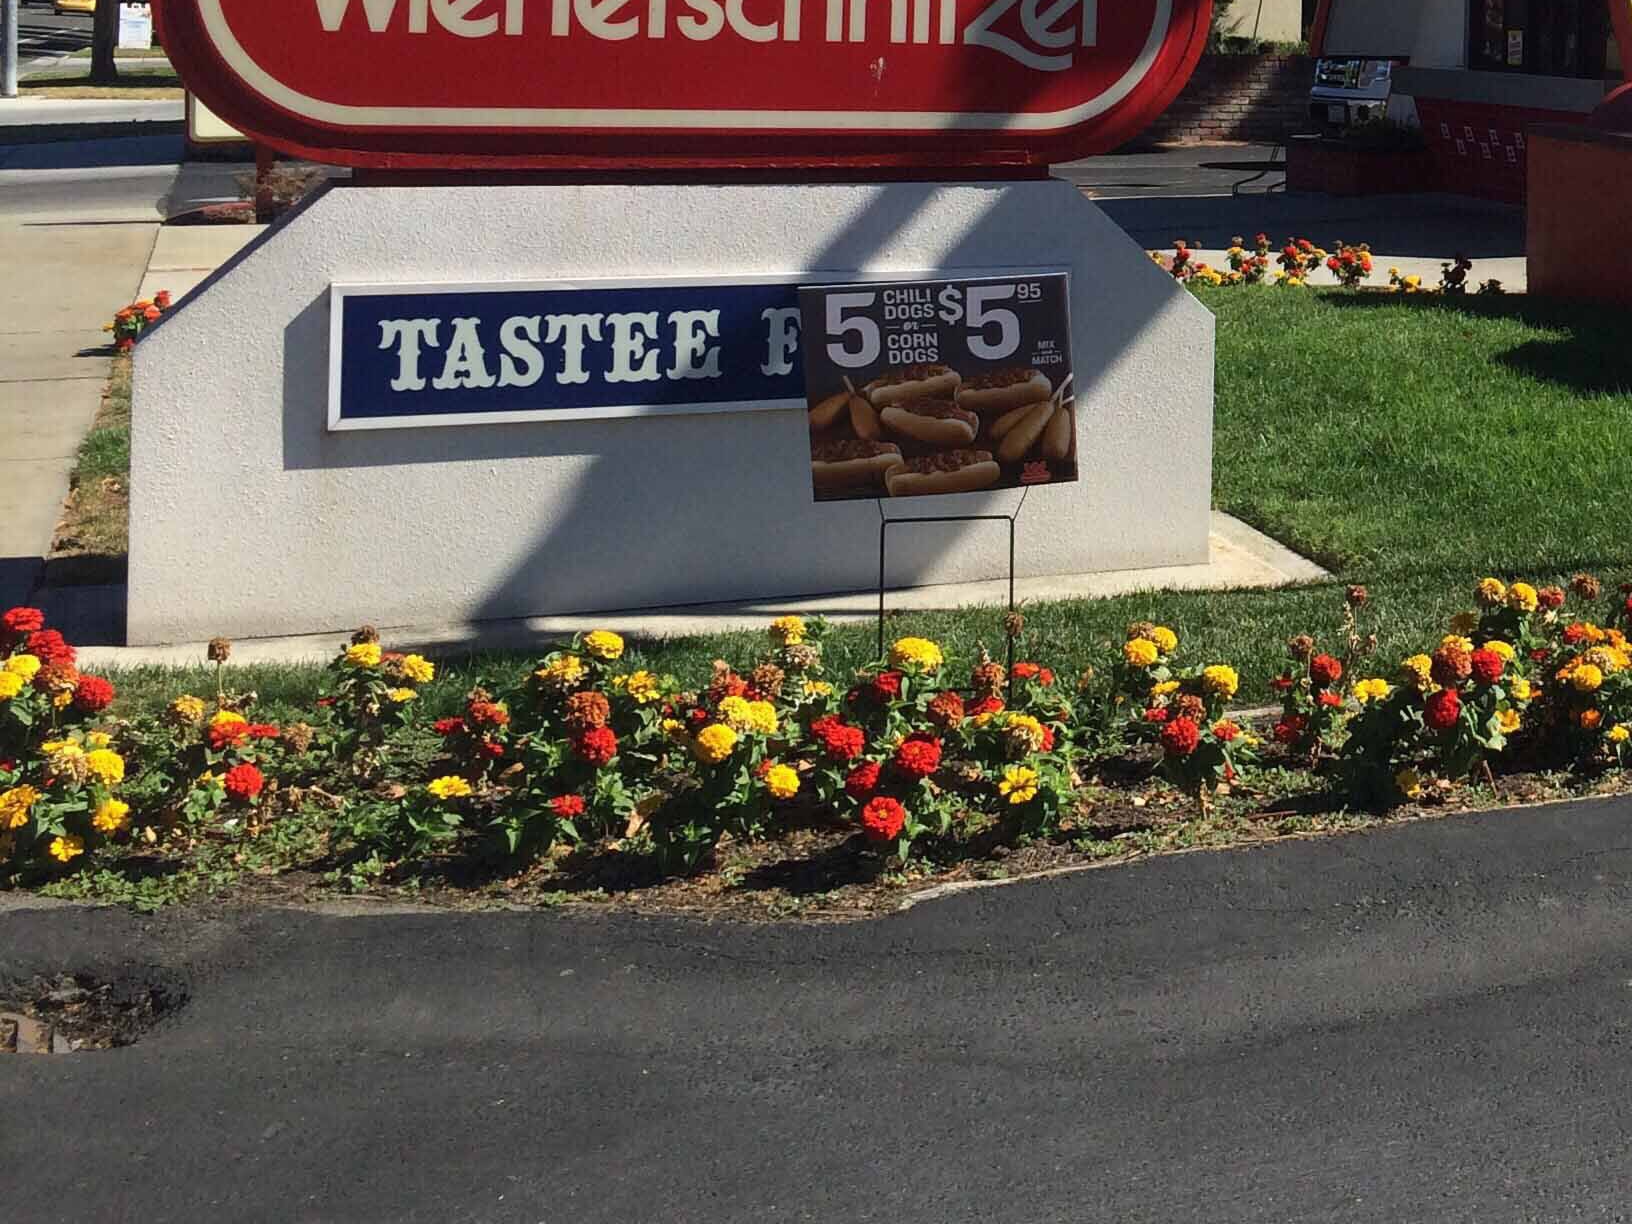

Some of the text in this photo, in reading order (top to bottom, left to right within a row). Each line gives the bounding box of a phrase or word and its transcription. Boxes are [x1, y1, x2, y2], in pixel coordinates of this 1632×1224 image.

[883, 288, 932, 305] CHILI
[884, 304, 935, 320] DOGS
[825, 292, 881, 368] 5
[887, 333, 938, 349] CORN
[377, 308, 723, 392] TASTEE
[888, 348, 939, 365] DOGS
